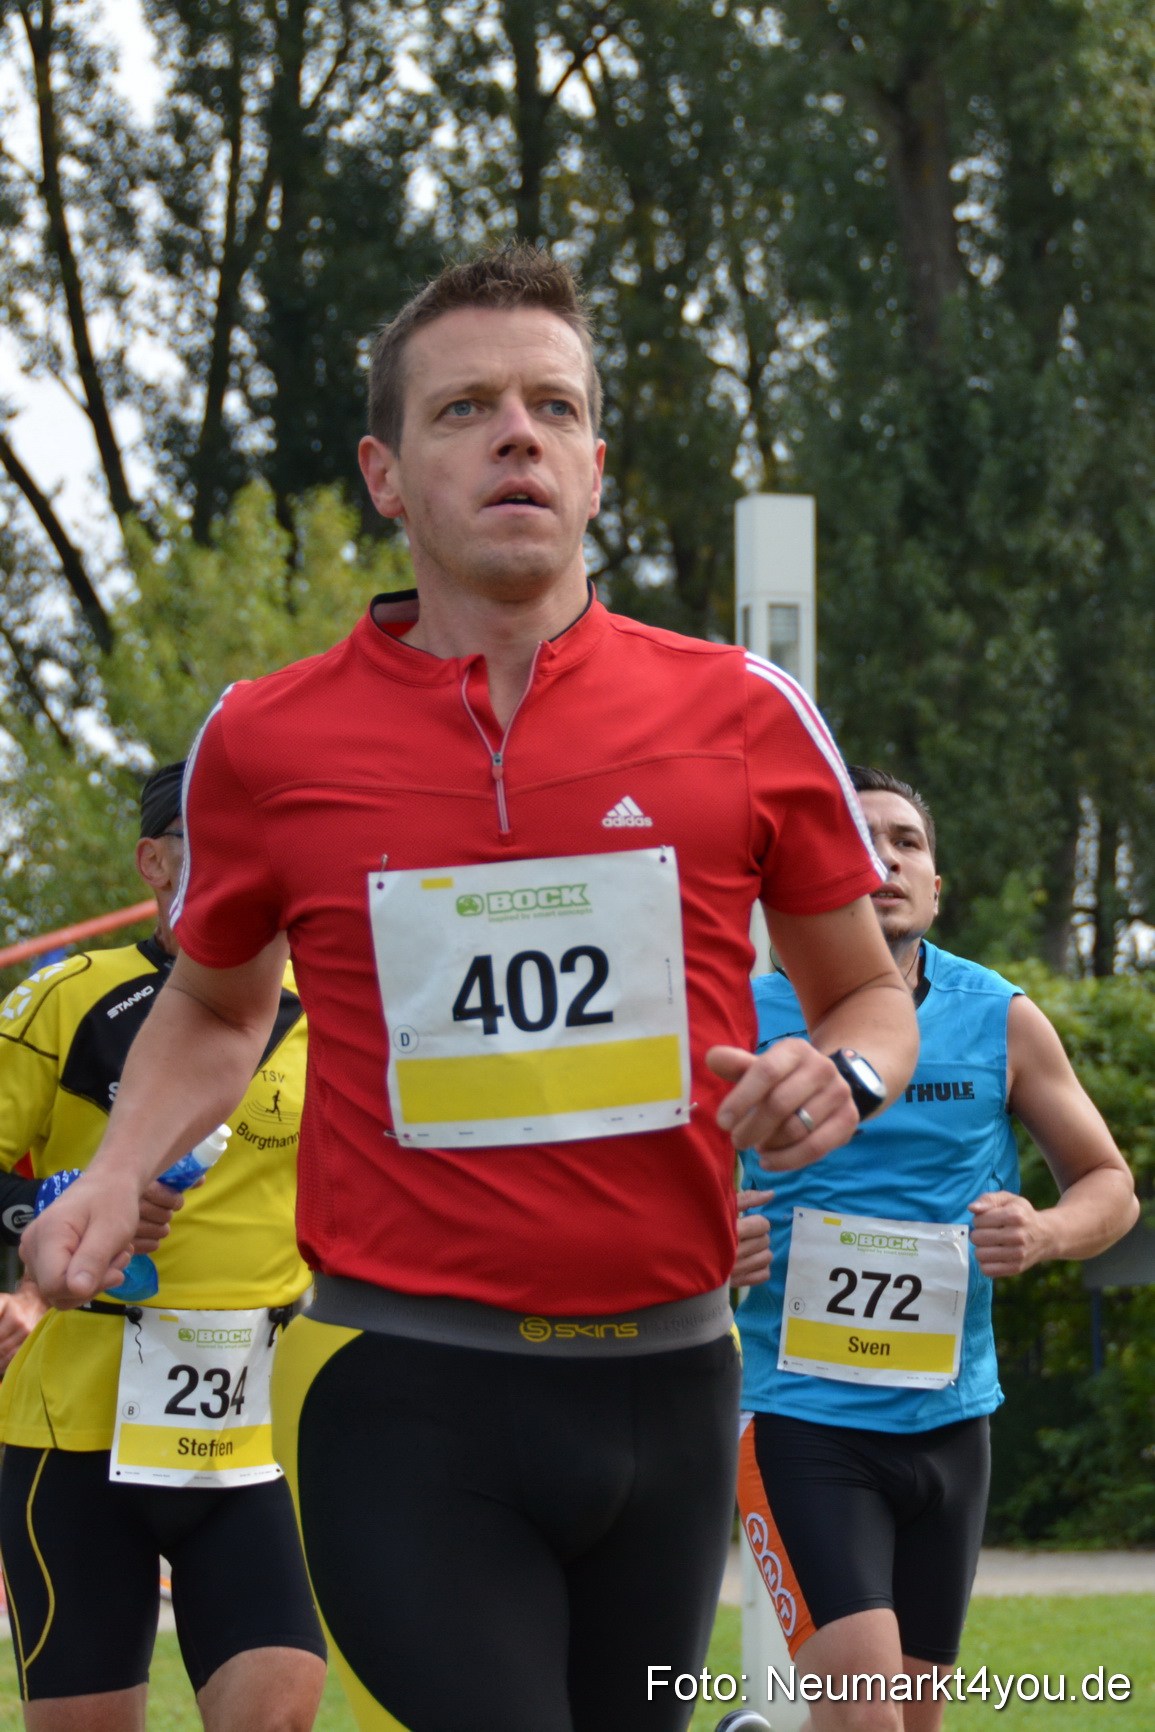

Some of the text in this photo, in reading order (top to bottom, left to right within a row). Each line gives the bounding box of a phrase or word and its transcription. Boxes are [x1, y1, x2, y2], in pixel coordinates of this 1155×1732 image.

[602, 815, 653, 828] adidas
[486, 883, 591, 915] BOCK
[452, 945, 614, 1036] 402
[107, 985, 154, 1020] STANNO
[400, 1032, 410, 1047] D
[261, 1070, 285, 1084] TSV
[905, 1081, 975, 1103] THULE
[236, 1121, 300, 1151] Burgthann
[857, 1233, 919, 1251] BOCK
[826, 1267, 922, 1322] 272
[794, 1301, 800, 1311] C
[197, 1328, 252, 1344] BOCK
[848, 1336, 890, 1356] Sven
[164, 1364, 248, 1419] 234
[128, 1405, 135, 1415] B
[747, 1514, 795, 1633] TNT
